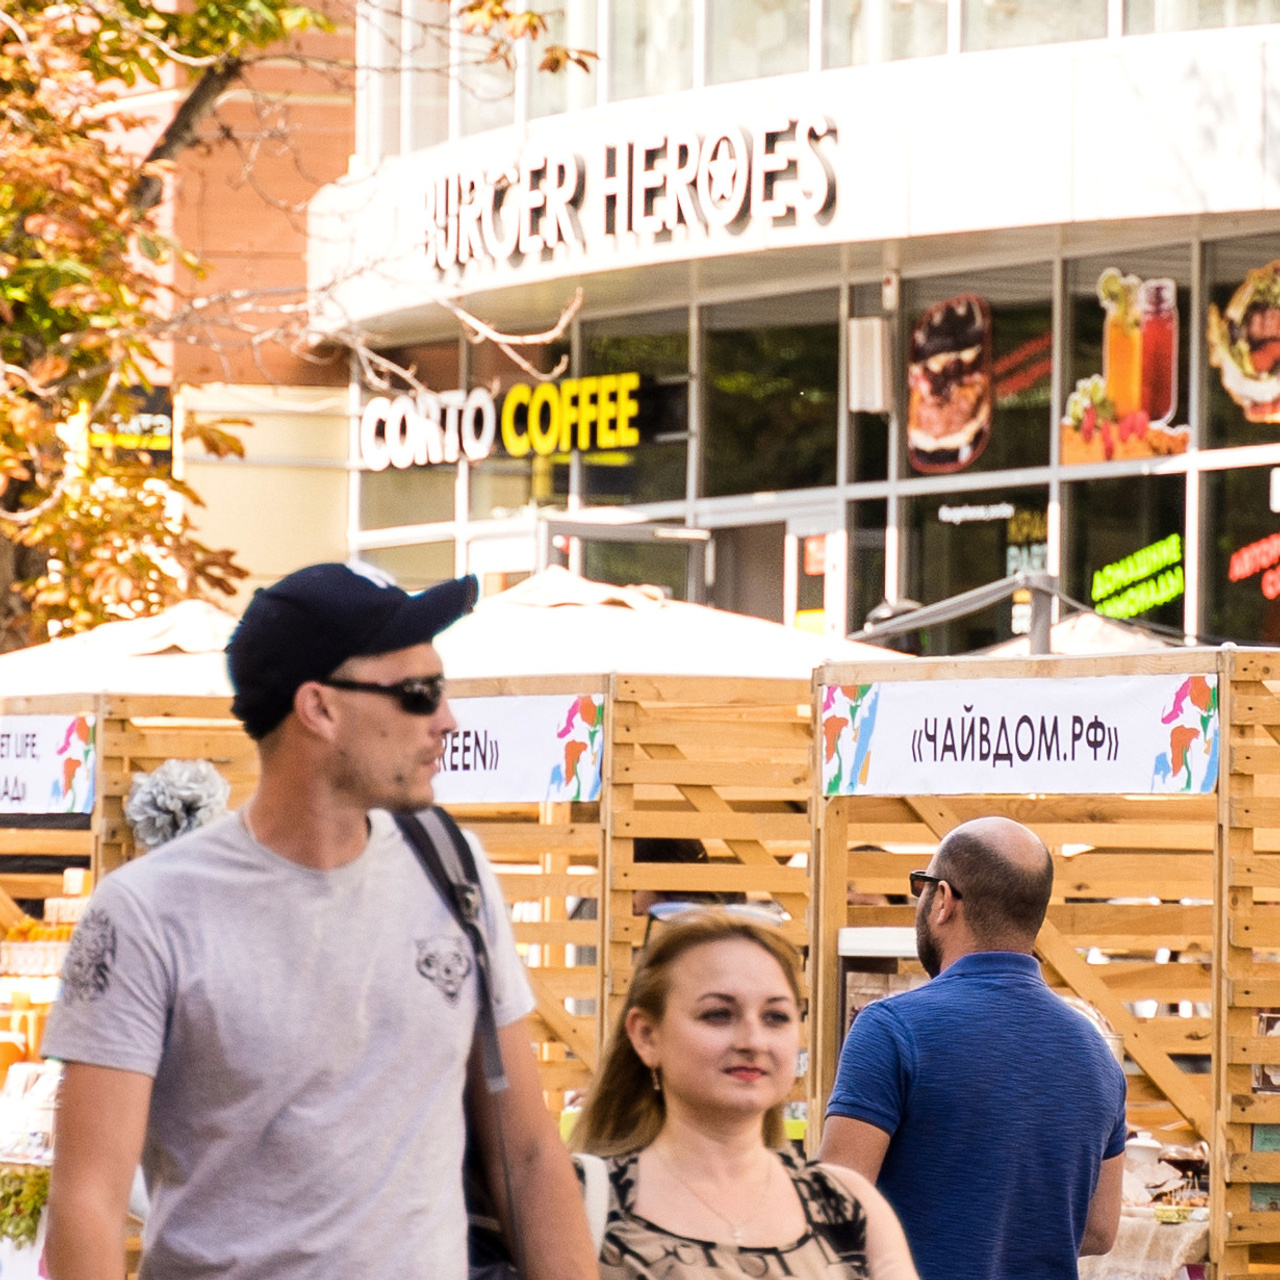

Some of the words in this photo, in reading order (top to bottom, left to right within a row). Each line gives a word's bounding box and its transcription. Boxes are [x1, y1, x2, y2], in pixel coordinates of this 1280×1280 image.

[598, 114, 838, 244] HEROES
[501, 371, 640, 457] COFFEE
[0, 733, 10, 758] ET
[437, 729, 499, 773] REEN»
[911, 704, 1119, 768] «ЧАЙВДОМ.РФ»
[0, 775, 26, 804] АД»
